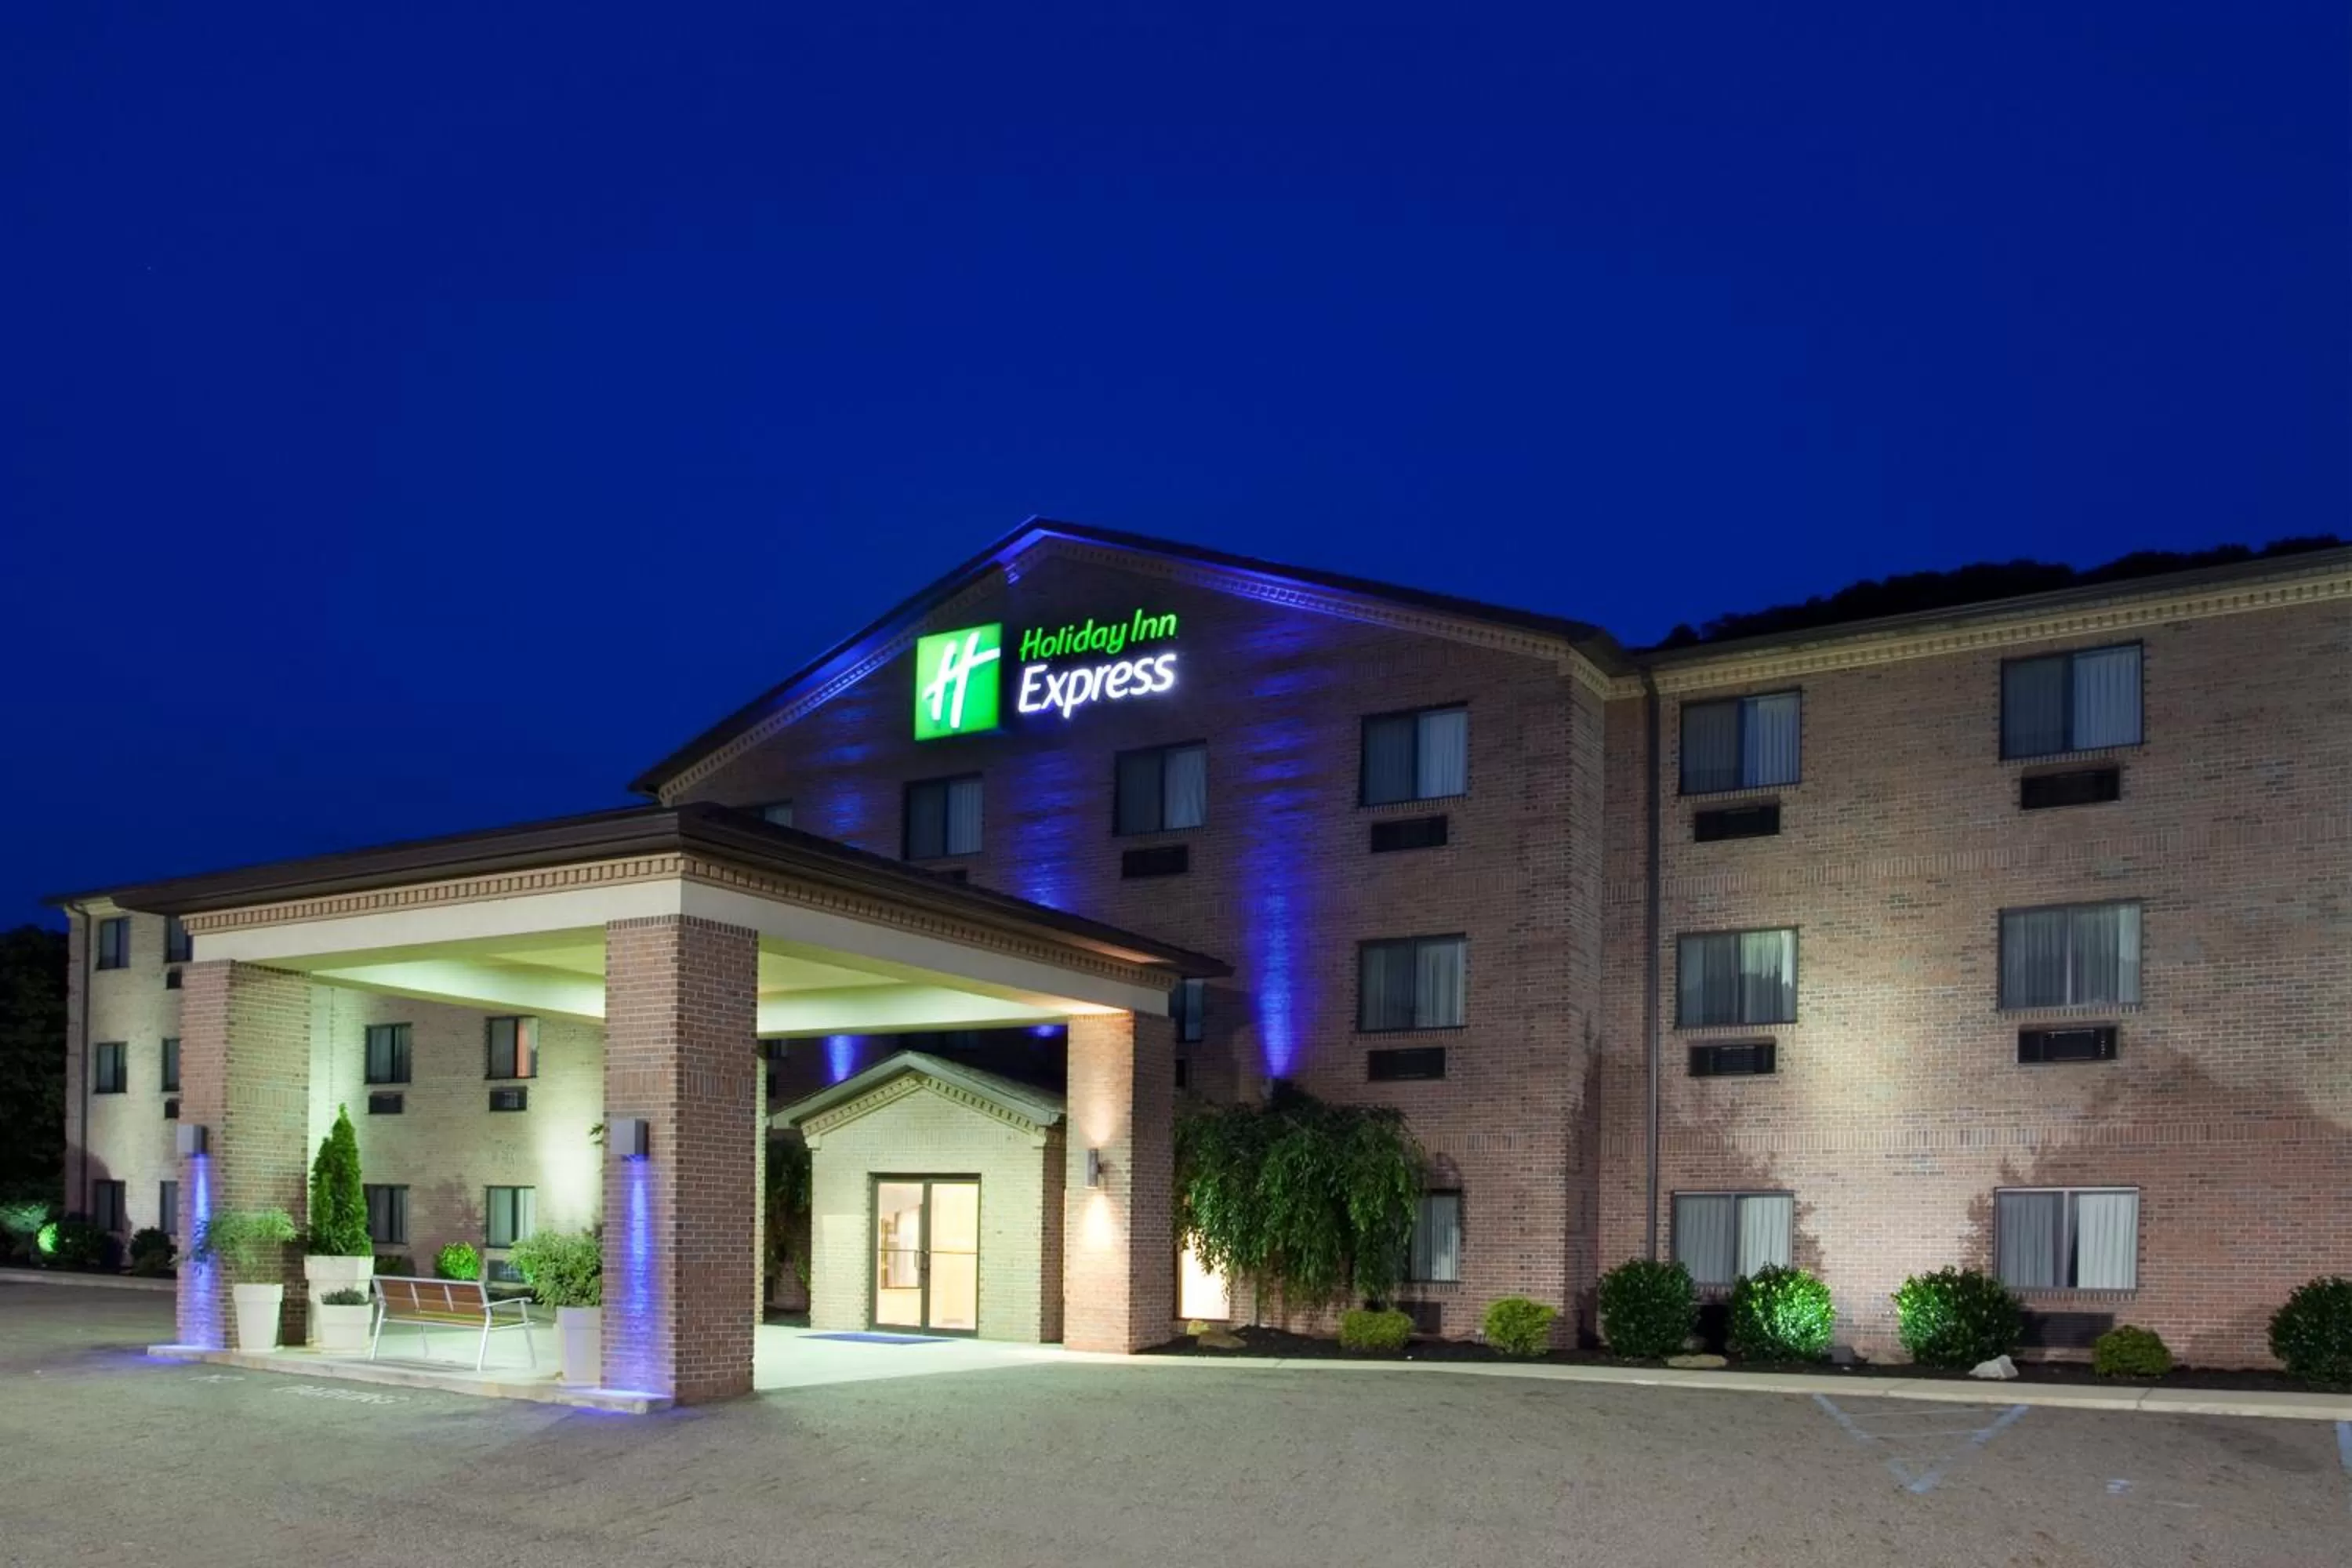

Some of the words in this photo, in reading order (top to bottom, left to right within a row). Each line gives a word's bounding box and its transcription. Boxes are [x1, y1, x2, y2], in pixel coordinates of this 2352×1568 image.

[1019, 618, 1128, 662] Holiday
[1130, 608, 1177, 642] Inn
[1018, 653, 1177, 718] Express
